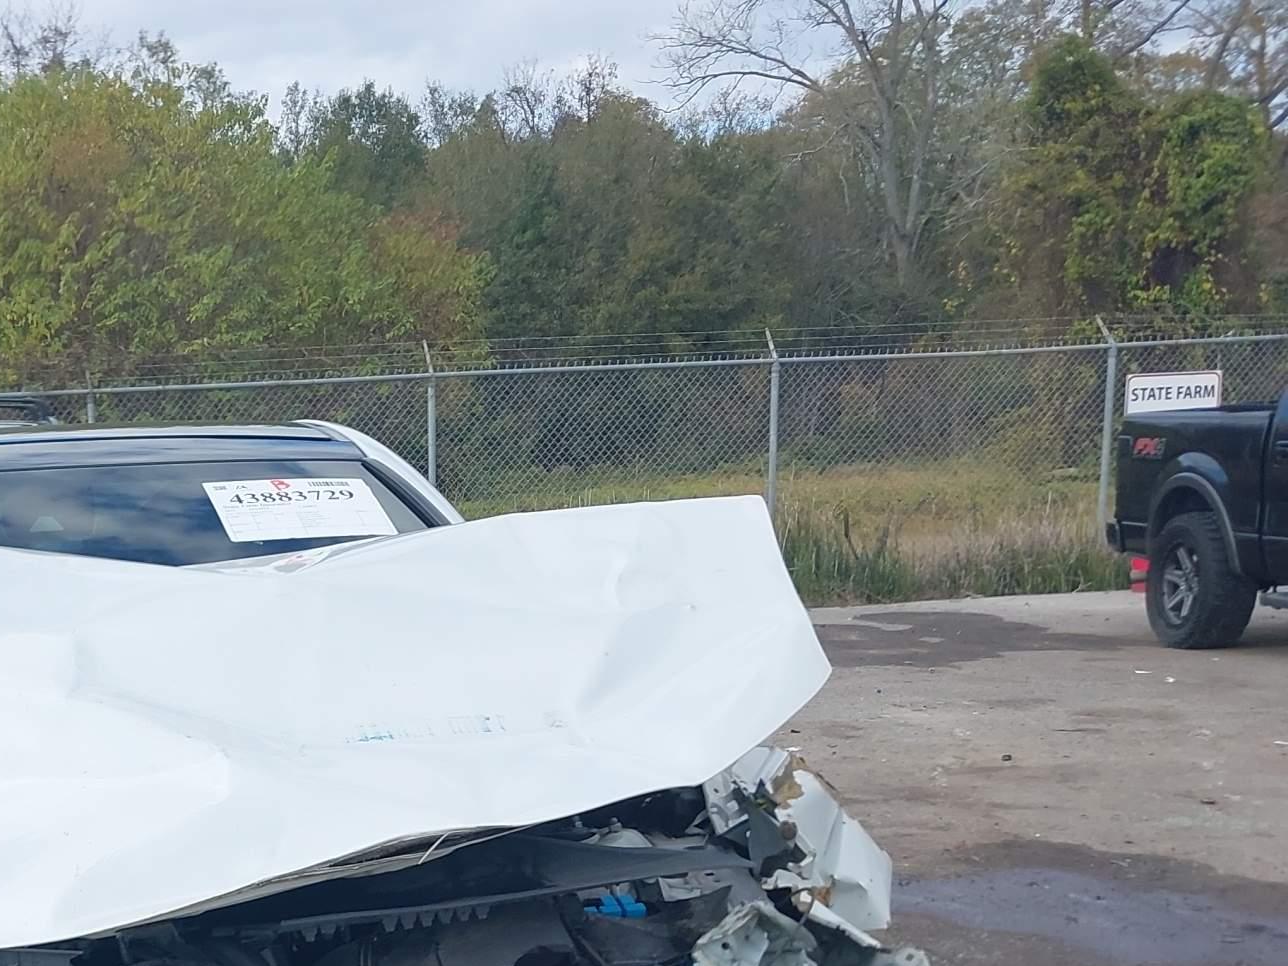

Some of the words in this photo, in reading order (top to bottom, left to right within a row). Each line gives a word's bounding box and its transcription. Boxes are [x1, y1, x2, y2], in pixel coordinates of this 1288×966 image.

[1131, 386, 1173, 402] STATE
[1176, 384, 1215, 400] FARM
[229, 489, 354, 505] 43883729
